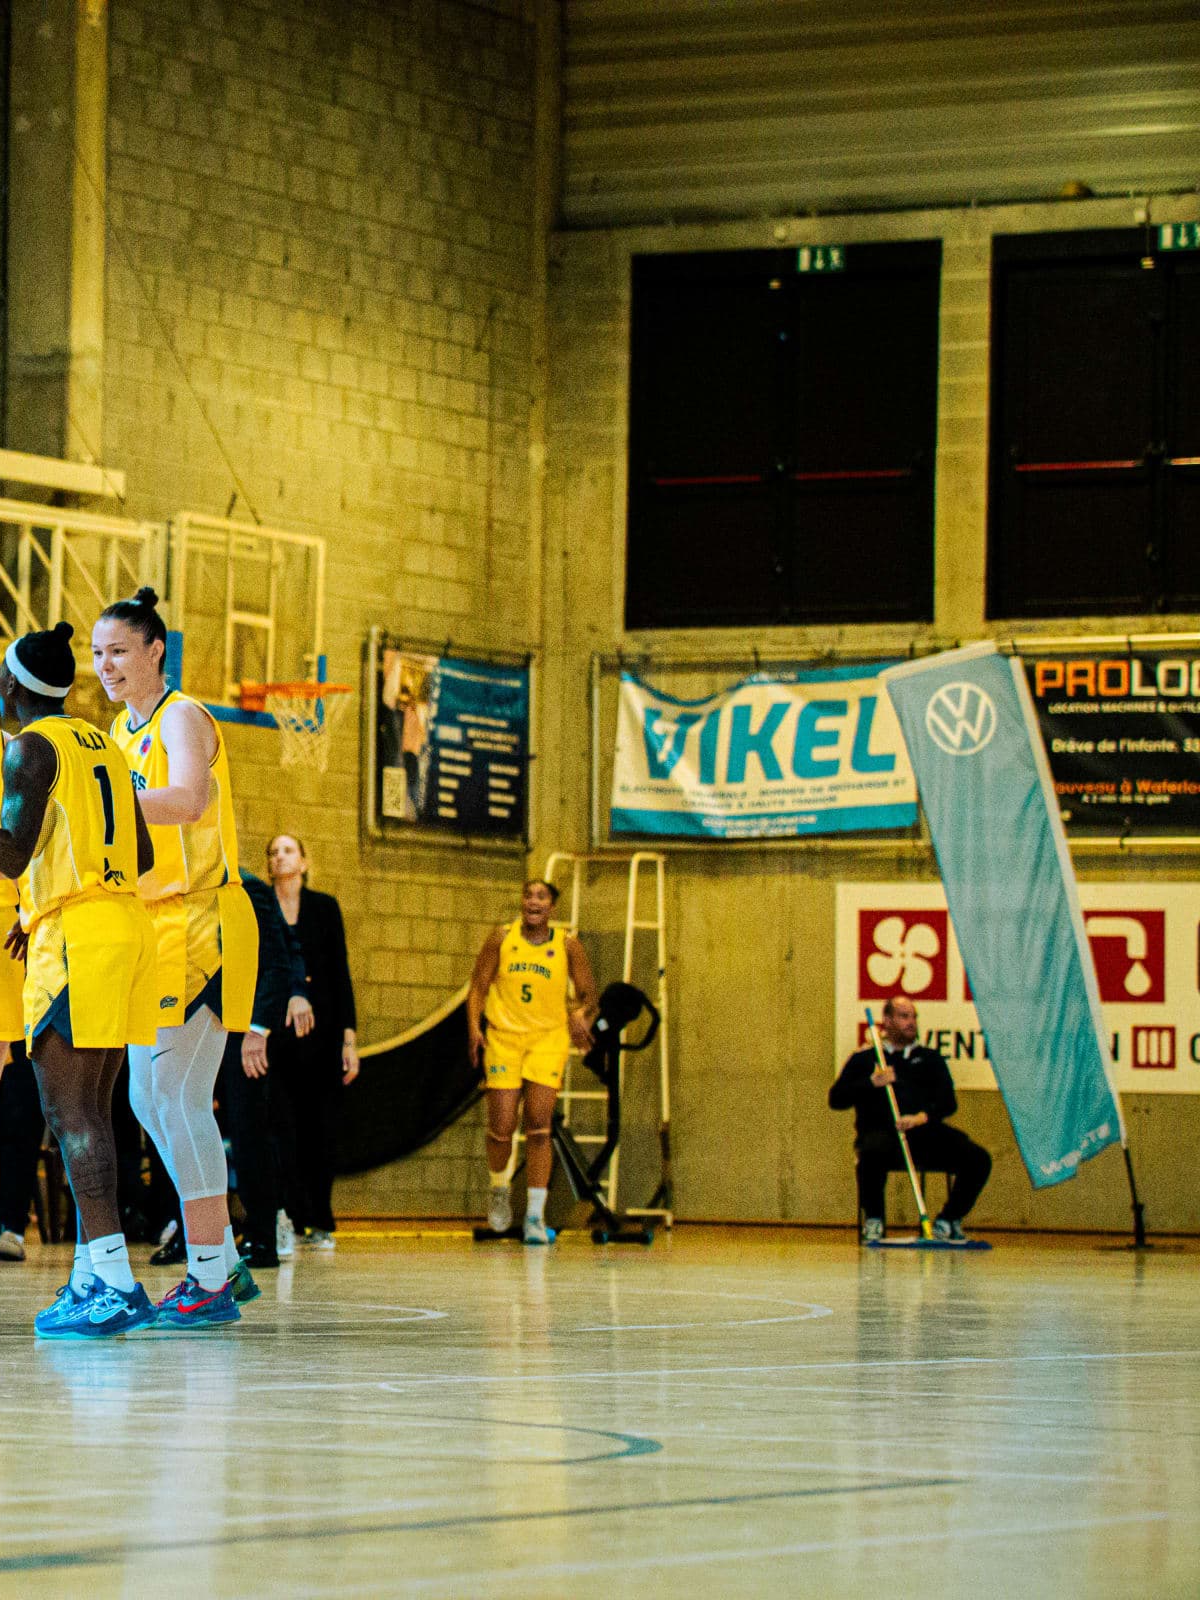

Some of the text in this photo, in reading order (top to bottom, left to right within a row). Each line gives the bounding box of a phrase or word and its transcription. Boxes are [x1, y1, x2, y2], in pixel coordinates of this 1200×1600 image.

[644, 695, 896, 785] VIKEL
[93, 764, 115, 846] 1
[521, 983, 533, 1004] 5
